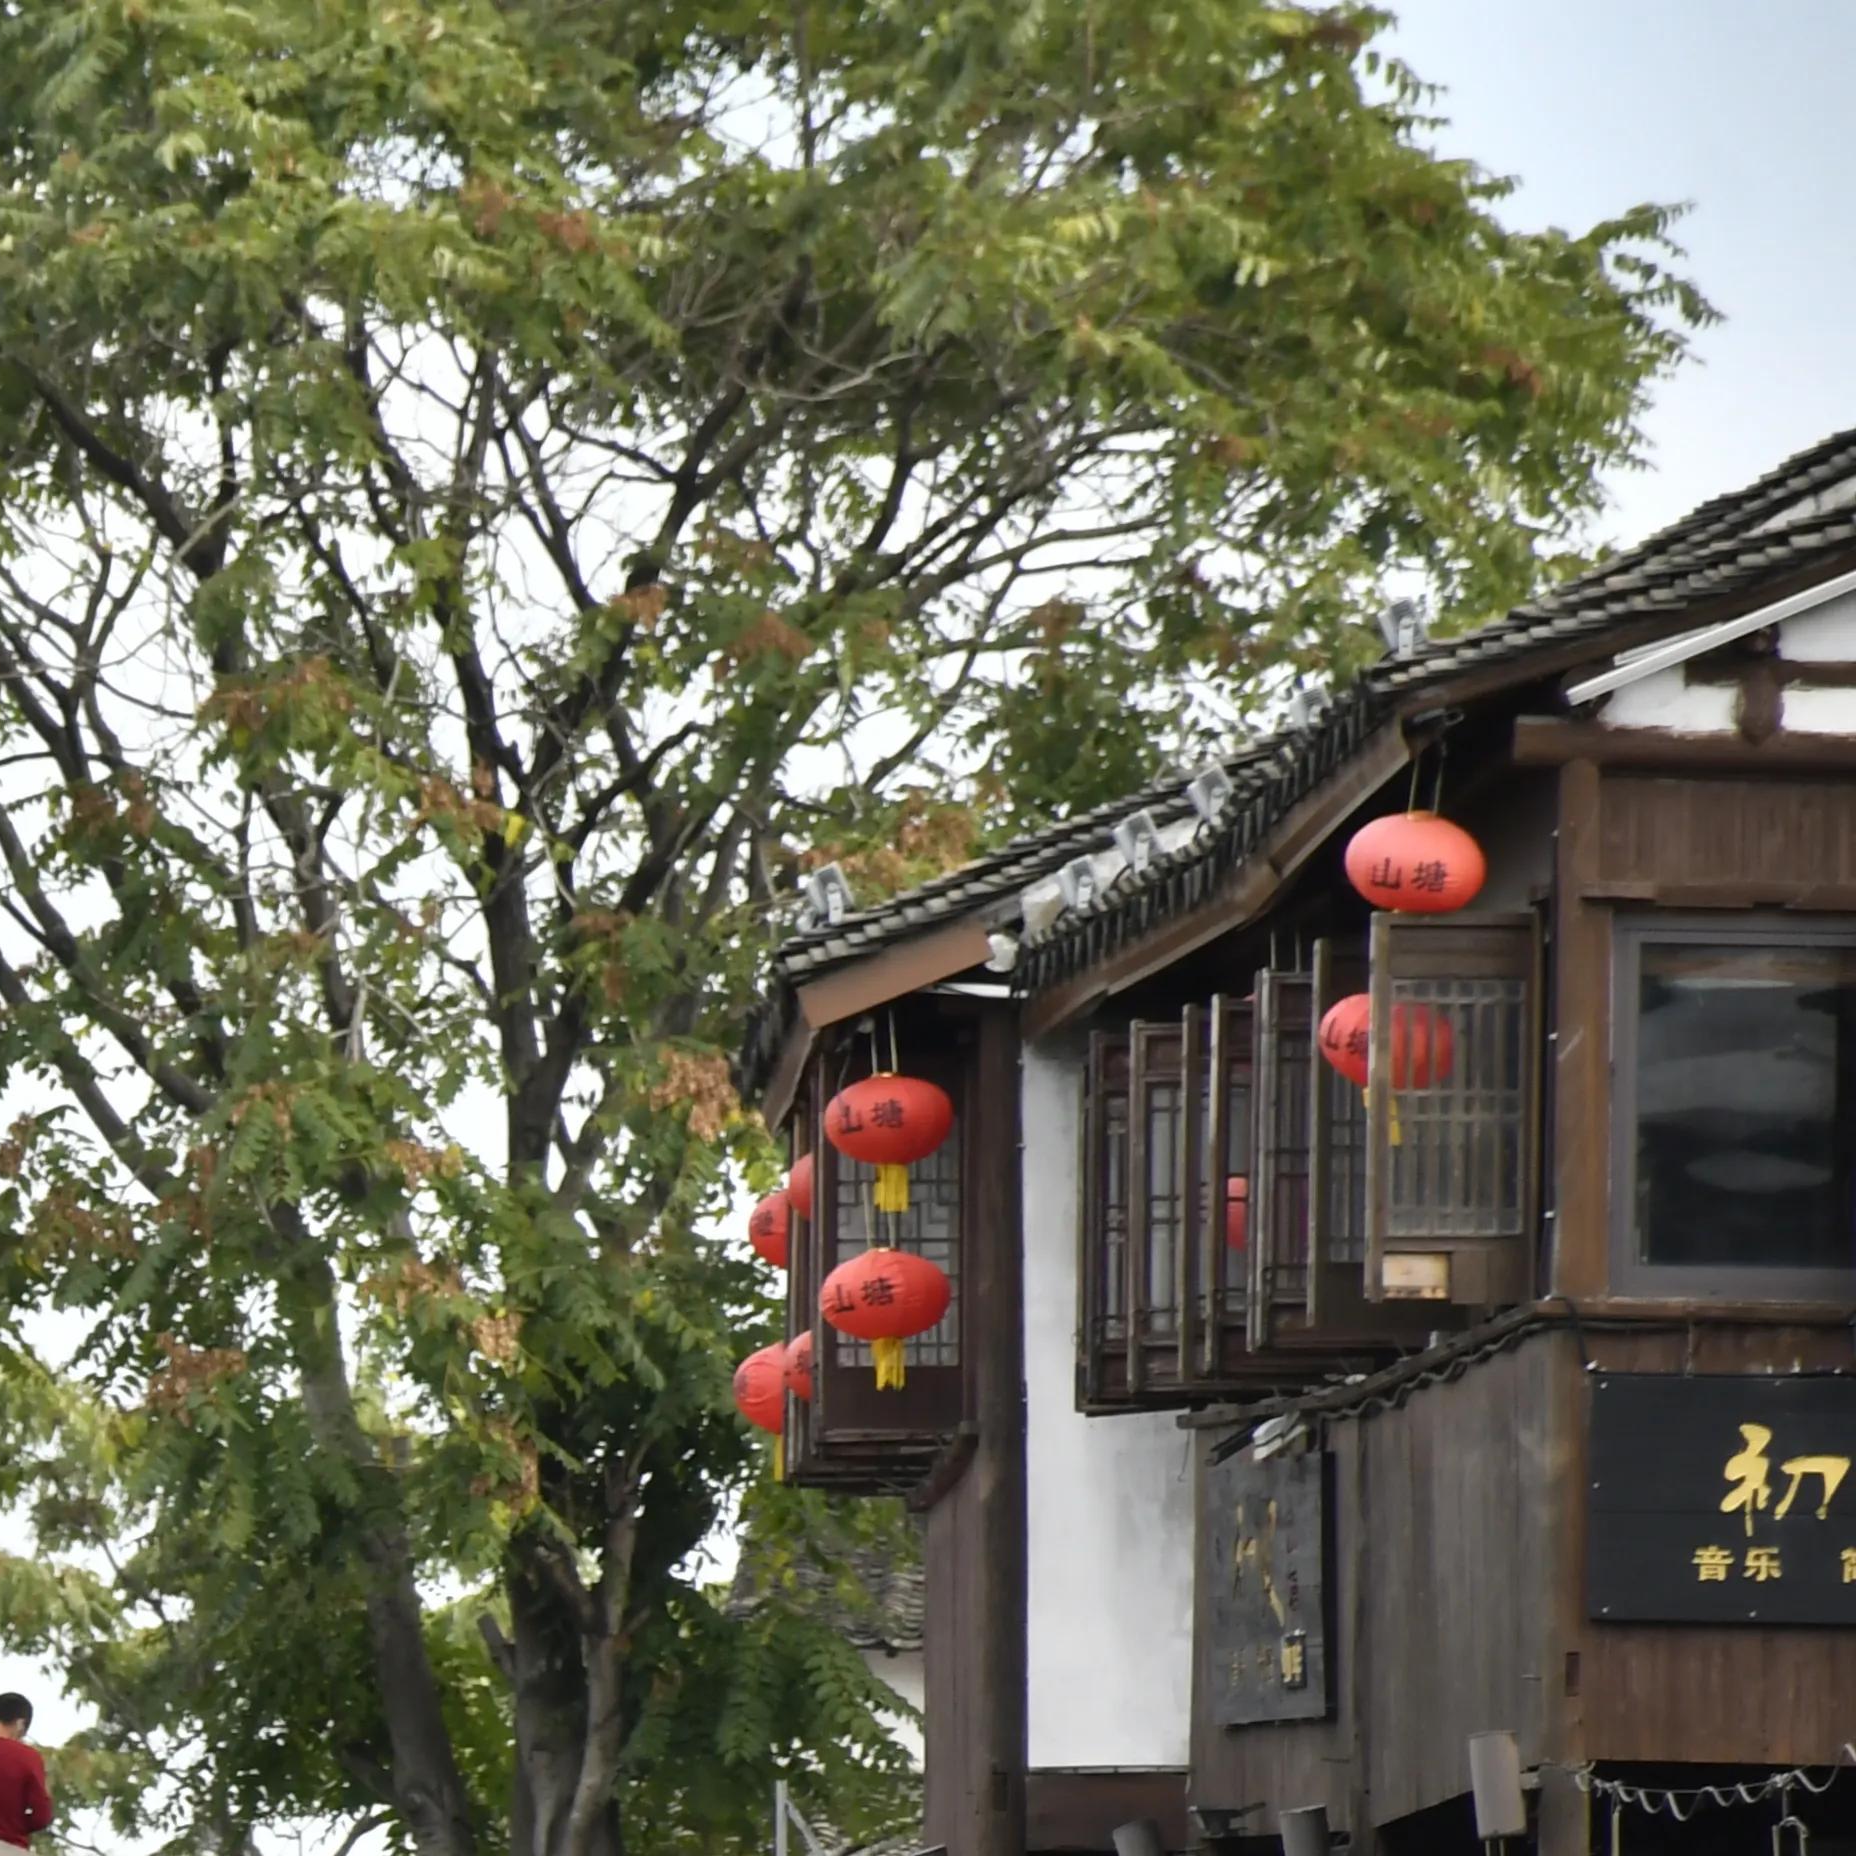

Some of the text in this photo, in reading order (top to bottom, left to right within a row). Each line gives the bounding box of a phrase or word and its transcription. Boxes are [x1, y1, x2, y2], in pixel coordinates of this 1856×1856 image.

[1371, 857, 1448, 893] 山塘
[839, 1099, 904, 1135] 山塘
[833, 1277, 895, 1314] 山塘
[1693, 1545, 1783, 1582] 音乐
